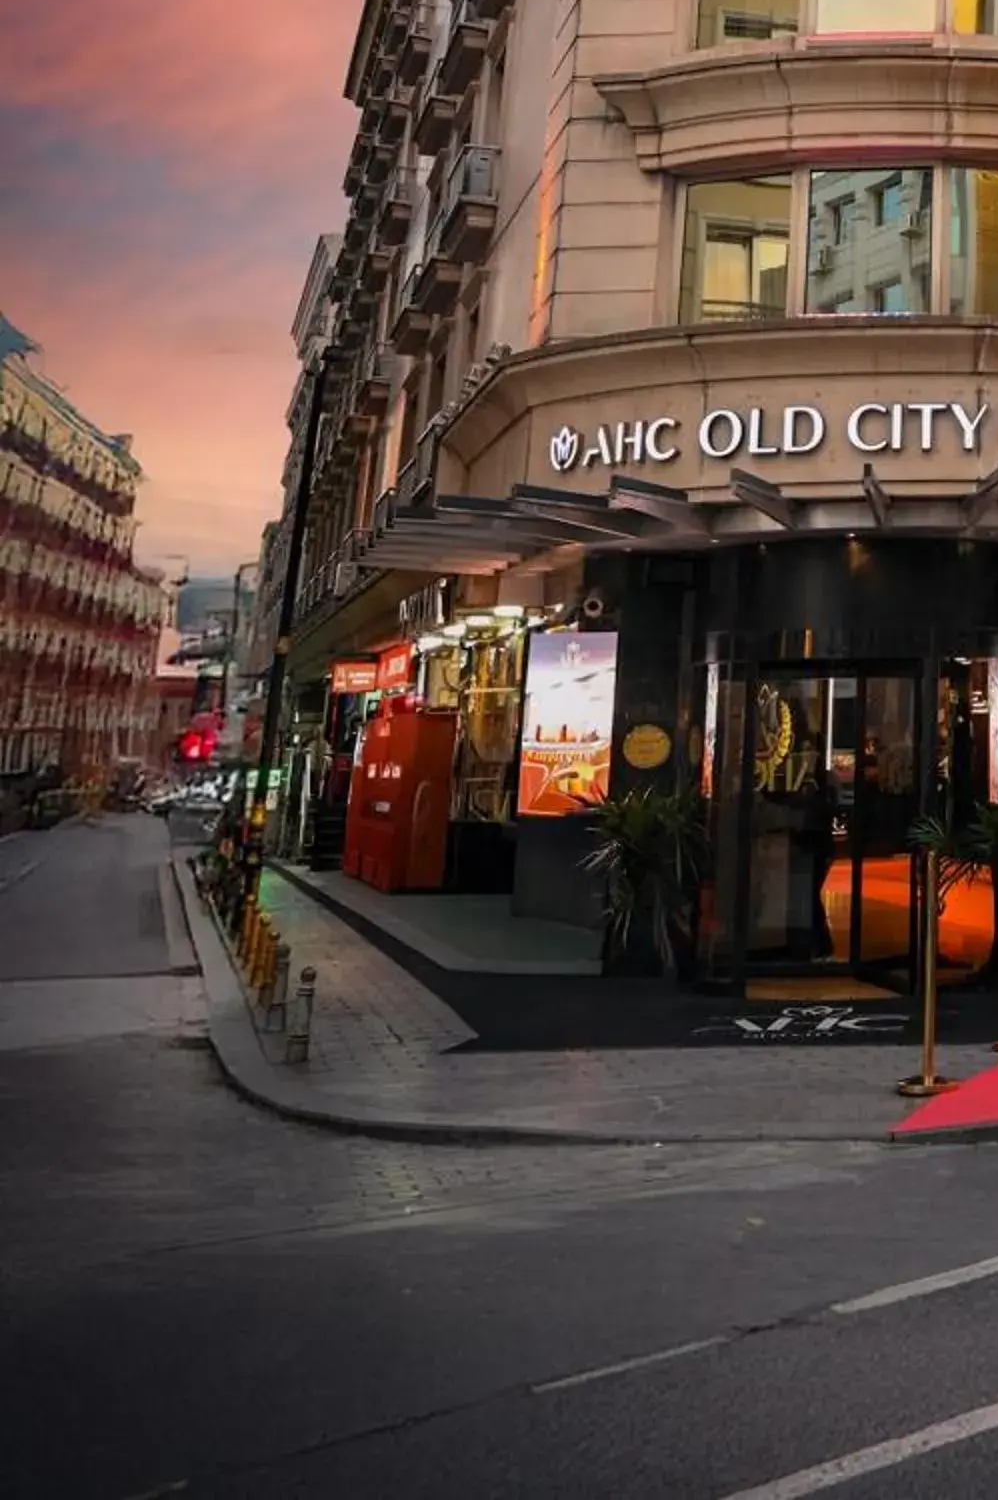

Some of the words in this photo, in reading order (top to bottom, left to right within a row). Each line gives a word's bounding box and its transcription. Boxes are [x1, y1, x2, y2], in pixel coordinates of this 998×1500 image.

[583, 417, 679, 467] AHC
[699, 406, 825, 457] OLD
[847, 403, 988, 451] CITY
